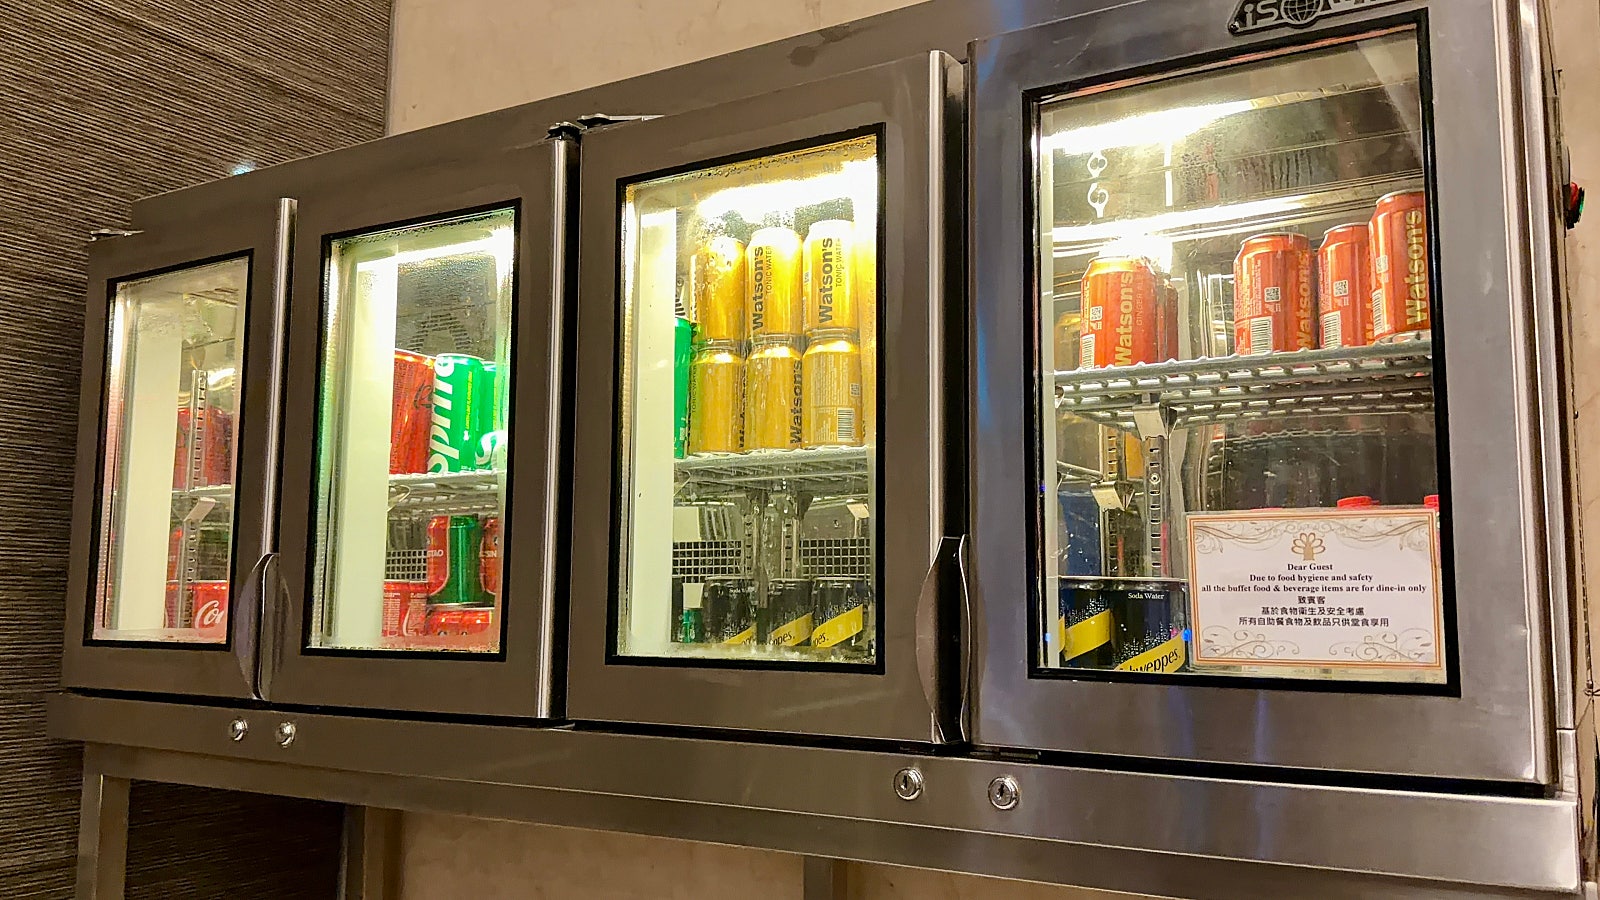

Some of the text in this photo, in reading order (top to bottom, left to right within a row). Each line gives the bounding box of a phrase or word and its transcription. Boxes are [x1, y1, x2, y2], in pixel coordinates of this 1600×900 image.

[752, 246, 764, 331] Watson's
[819, 237, 833, 323] Watson's
[1404, 210, 1427, 325] Watson's
[1115, 272, 1133, 366] Watson's
[1296, 251, 1312, 348] Watson's
[790, 360, 802, 444] Watson's
[1201, 584, 1211, 592] all
[1213, 584, 1226, 592] the
[1227, 584, 1251, 592] buffet
[1253, 584, 1271, 592] food
[1283, 584, 1320, 593] beverage
[1321, 584, 1344, 592] items
[1361, 584, 1375, 592] for
[1376, 584, 1406, 592] dine-in
[1408, 584, 1427, 593] only
[1249, 574, 1266, 582] Due
[1277, 574, 1295, 582] food
[1297, 574, 1329, 583] hygiene
[1331, 573, 1347, 581] and
[1348, 573, 1373, 583] safety
[1287, 562, 1333, 571] Dear Guest
[1127, 592, 1165, 600] Soda Water
[1261, 606, 1365, 616] 基於食物衛生及安全考慮
[1238, 616, 1390, 627] 所有自助餐食物及飲品只供堂食享用
